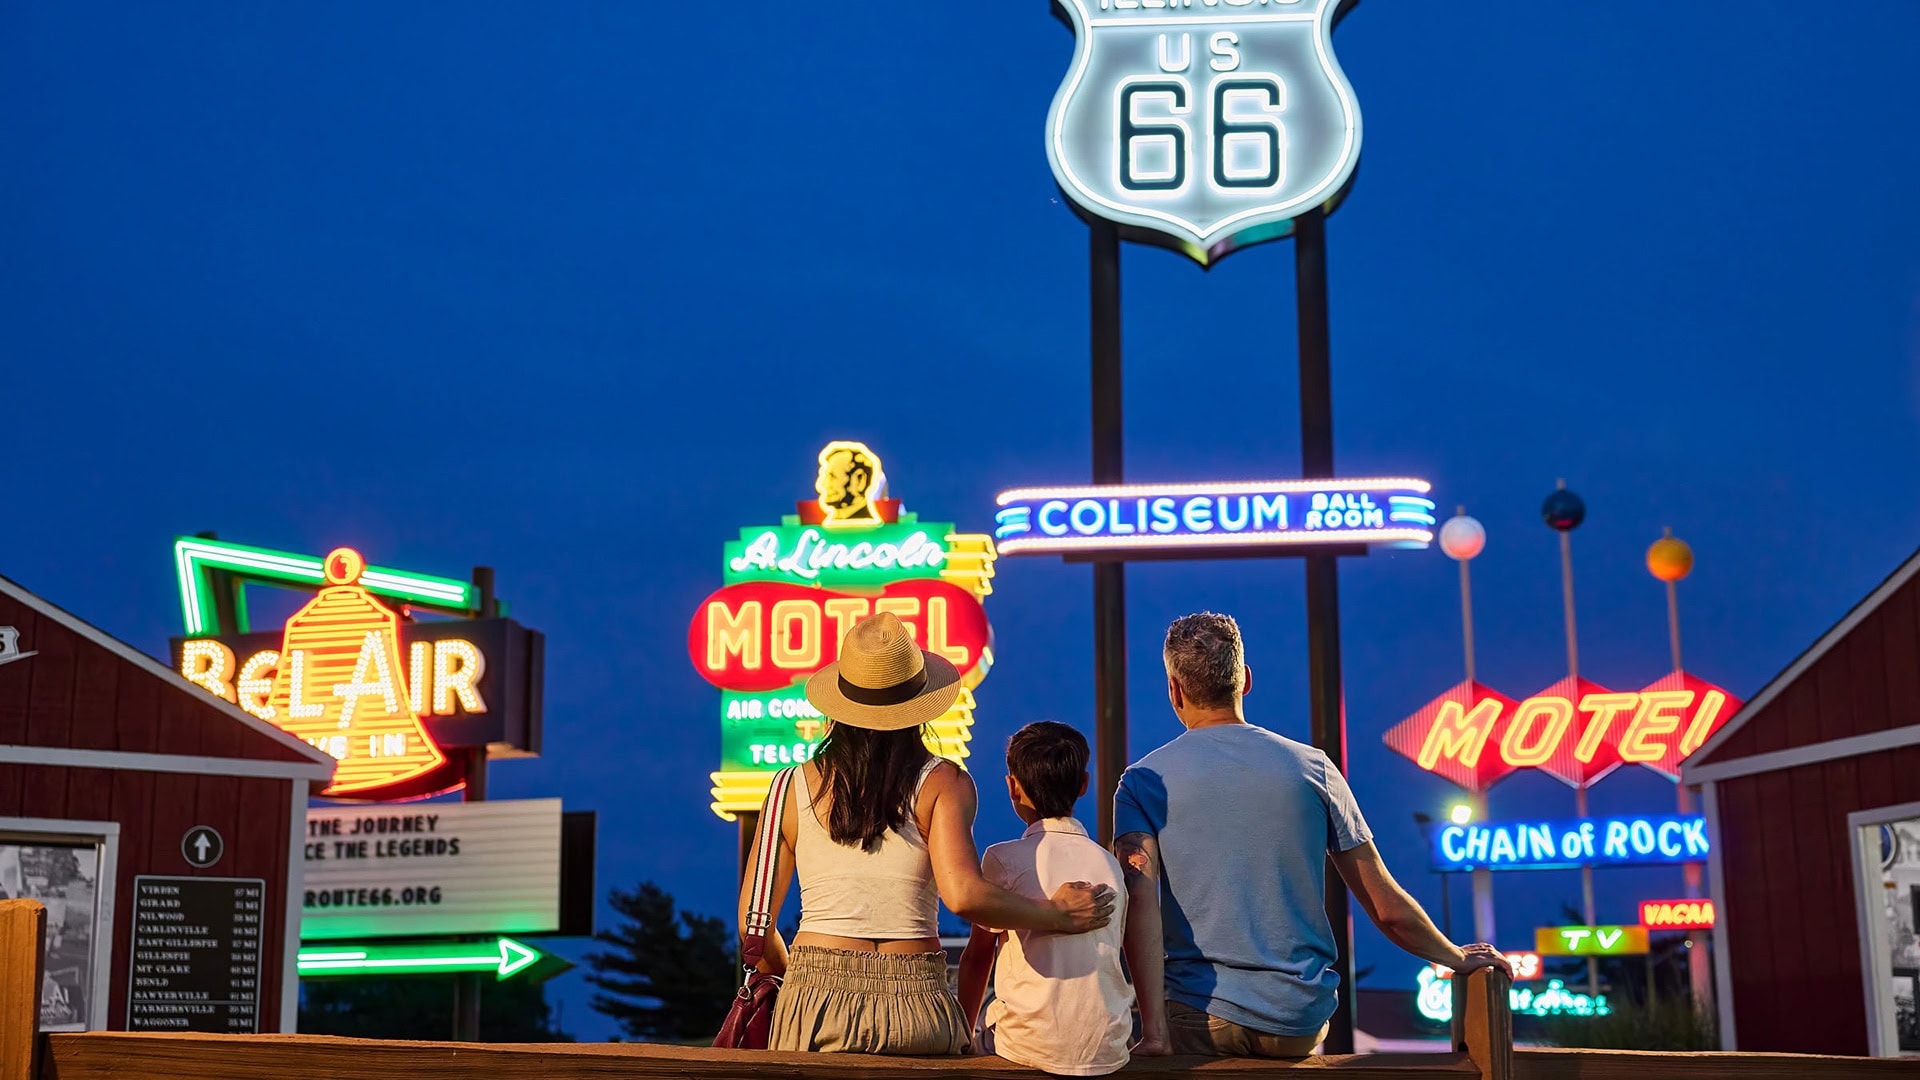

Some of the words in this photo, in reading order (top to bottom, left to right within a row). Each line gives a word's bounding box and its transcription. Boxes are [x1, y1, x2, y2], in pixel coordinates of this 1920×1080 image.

[1113, 72, 1287, 199] 66
[1311, 492, 1376, 511] BALL
[1038, 495, 1288, 535] COLISEUM
[1305, 508, 1385, 529] ROOM
[778, 530, 945, 579] Lincoln
[332, 629, 487, 729] AIR
[727, 699, 763, 720] AIR
[370, 732, 405, 758] IN
[309, 818, 341, 837] THE
[350, 815, 439, 836] JOURNEY
[334, 841, 368, 860] THE
[375, 838, 460, 859] LEGENDS
[1441, 822, 1556, 863] CHAIN
[1562, 823, 1595, 860] of
[1603, 818, 1710, 858] ROCK
[140, 899, 181, 908] GIRARD
[304, 886, 442, 908] ROUTE66.ORG
[139, 912, 185, 922] NILWOOD
[138, 925, 209, 935] CARLINVILLE
[137, 938, 164, 948] EAST
[165, 938, 218, 948] GILLESPIE
[136, 951, 191, 961] GILLESPIE
[136, 965, 152, 974] MT
[155, 965, 191, 974] CLARE
[135, 977, 169, 987] BENLD
[134, 991, 209, 1001] SAWYERVILLE
[133, 1004, 216, 1014] FARMERSVILLE
[133, 1017, 190, 1027] WAGGONER
